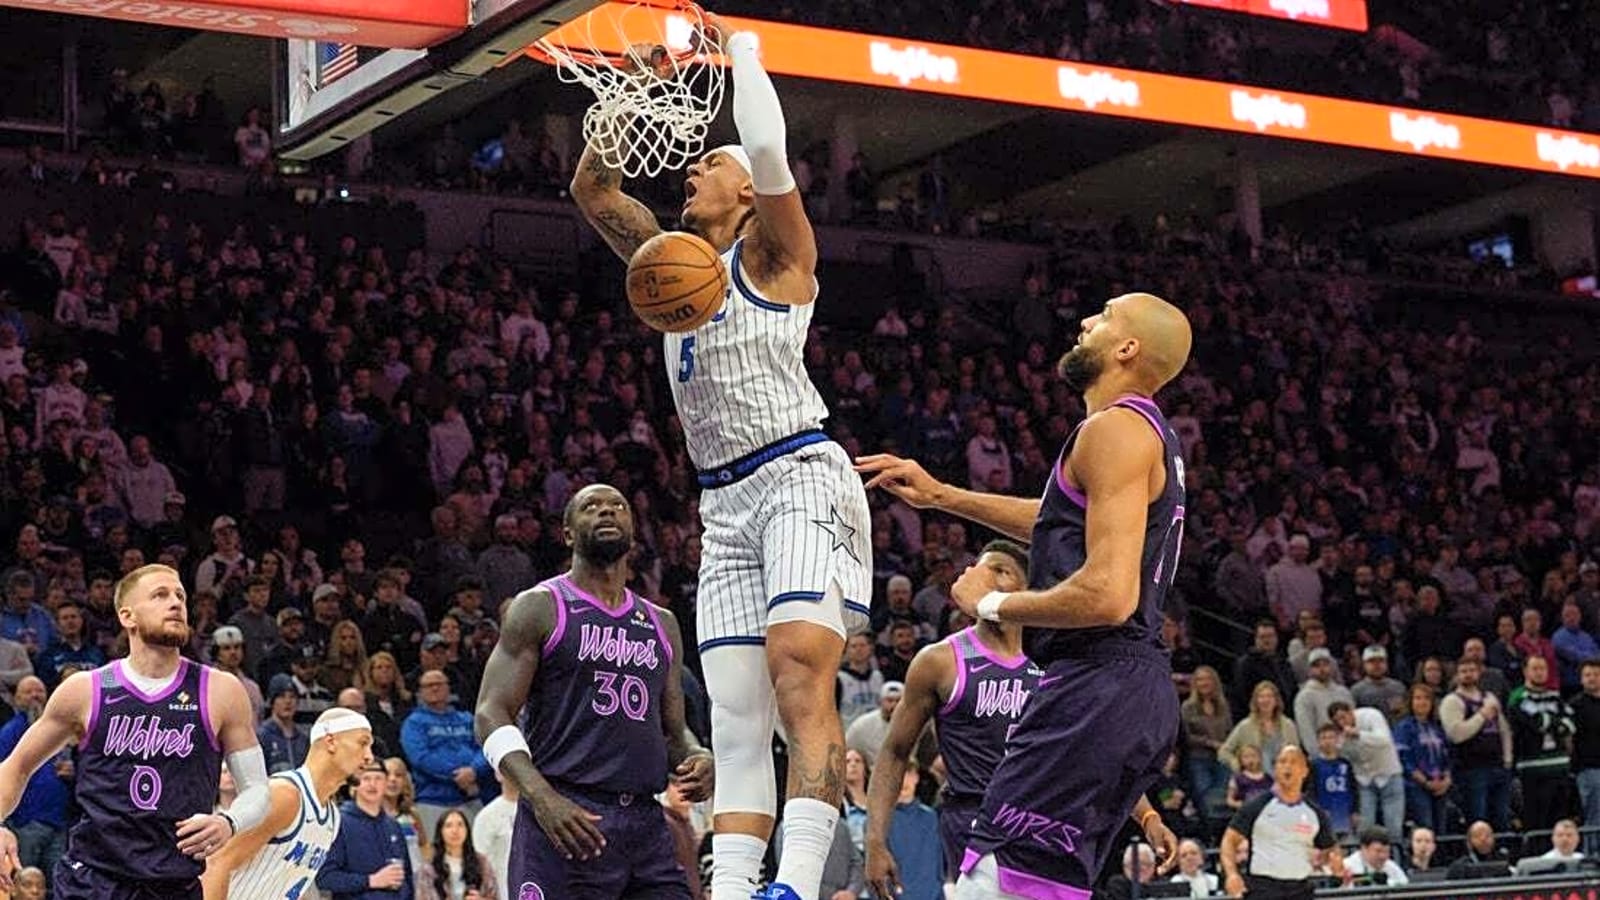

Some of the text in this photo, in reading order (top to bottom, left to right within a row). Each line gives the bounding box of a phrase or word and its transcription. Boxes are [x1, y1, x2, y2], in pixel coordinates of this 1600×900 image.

[678, 336, 696, 383] 5
[578, 623, 659, 670] Wolves
[591, 670, 649, 721] 30
[103, 715, 195, 760] Wolves
[1325, 775, 1347, 793] 62
